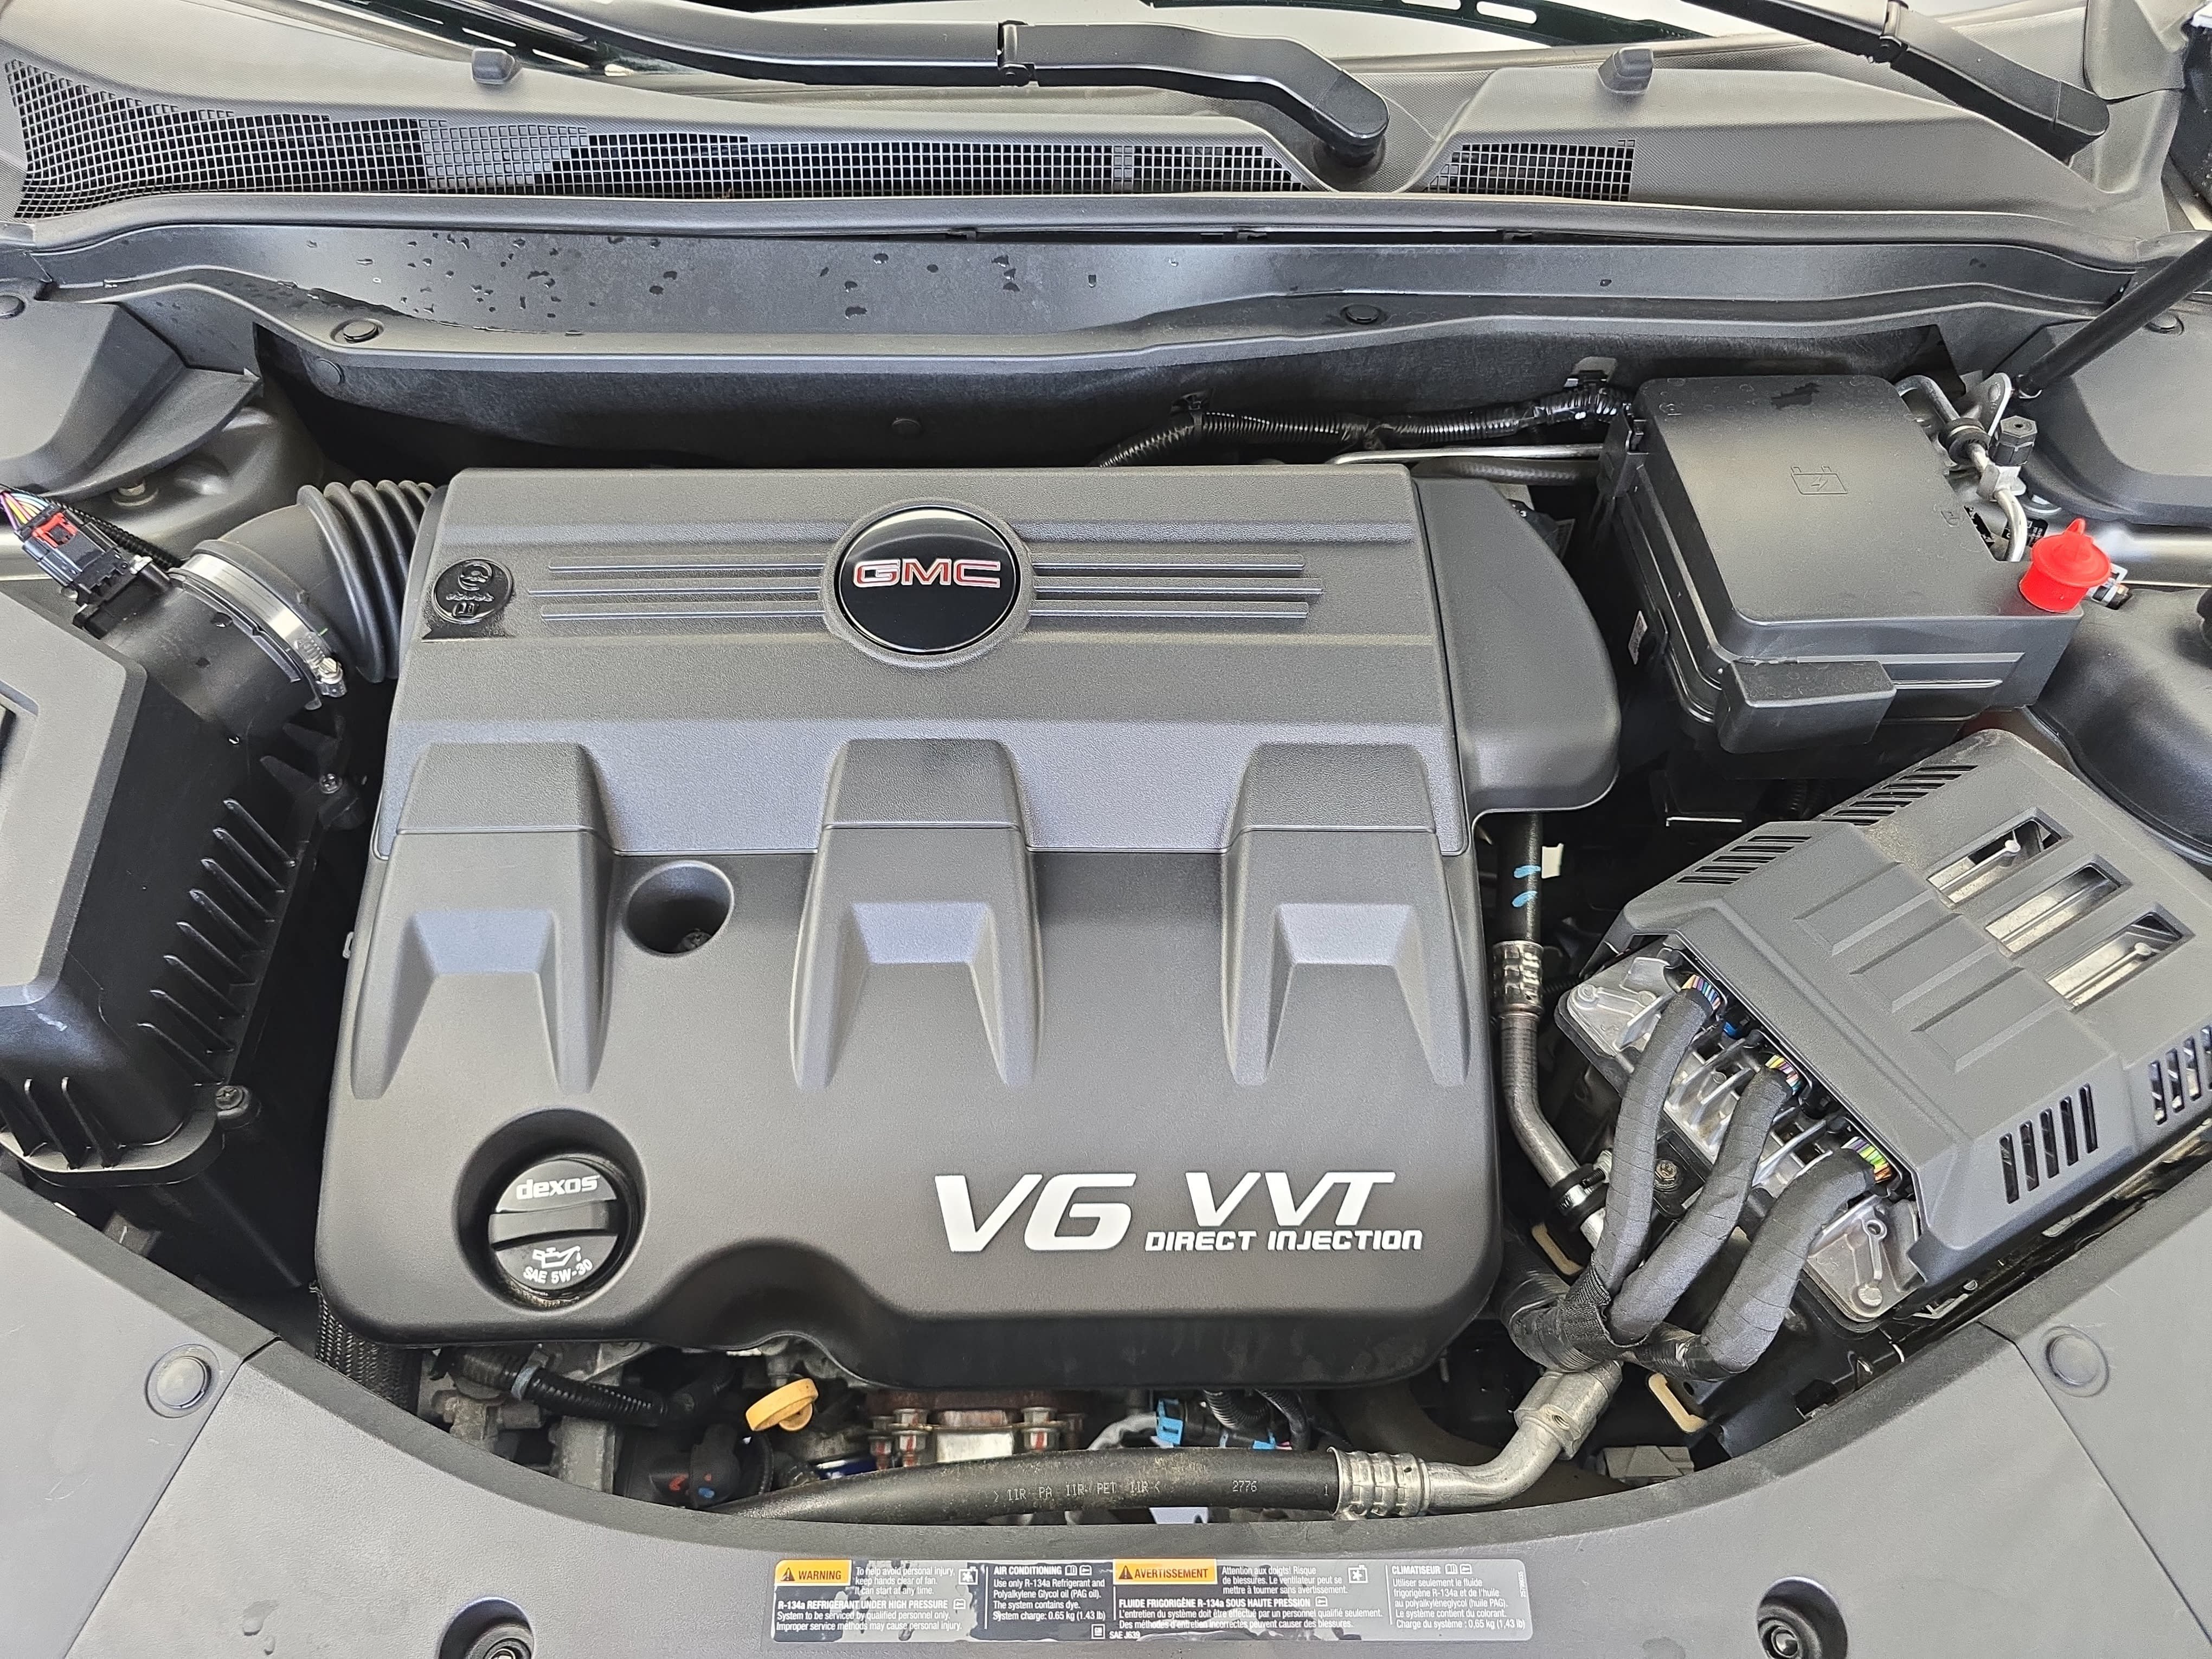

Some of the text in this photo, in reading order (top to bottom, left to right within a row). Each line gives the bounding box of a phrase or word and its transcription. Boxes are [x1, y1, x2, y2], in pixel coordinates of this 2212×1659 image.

[853, 558, 1001, 589] GMC
[516, 1175, 599, 1200] dexos
[1185, 1171, 1397, 1227] VVT
[935, 1172, 1137, 1252] V6
[1144, 1229, 1423, 1252] DIRECT INJECTION
[523, 1258, 594, 1284] SAE 5W-30
[1039, 1486, 1052, 1499] PA
[1097, 1482, 1116, 1494] PET
[1232, 1480, 1257, 1492] 2776
[799, 1570, 841, 1580] WARNING
[856, 1566, 955, 1577] To help avoid personal injury,
[994, 1566, 1062, 1575] AIR CONDITIONING
[1135, 1568, 1208, 1578] AVERTISSEMENT
[1222, 1566, 1252, 1575] Attention
[1268, 1566, 1291, 1576] doigts!
[1293, 1566, 1316, 1576] Risque
[1392, 1565, 1441, 1574] CLIMATISEUR
[856, 1577, 937, 1586] keep hands clear of fan.
[994, 1578, 1105, 1589] Use only R-134a Refrigerant and
[1222, 1576, 1231, 1584] de
[1233, 1576, 1268, 1584] blessures.
[1269, 1576, 1278, 1584] Le
[1279, 1576, 1315, 1584] ventilateur
[1317, 1576, 1332, 1585] peut
[1392, 1578, 1482, 1587] Utiliser seulement le fluide
[855, 1586, 860, 1594] It
[876, 1586, 892, 1594] start
[893, 1586, 901, 1594] at
[902, 1588, 916, 1596] any
[917, 1586, 934, 1594] time.
[993, 1590, 1101, 1600] Polyalkylene Glycol oil (PAG oil).
[1223, 1586, 1245, 1594] mettre
[1247, 1585, 1252, 1594] à
[1253, 1586, 1278, 1594] tourner
[1297, 1585, 1348, 1593] avertissement.
[1393, 1589, 1430, 1599] frigorigène
[1432, 1589, 1458, 1597] R-134a
[1468, 1589, 1477, 1597] de
[1478, 1588, 1500, 1597] l'huile
[777, 1600, 948, 1610] R-134a REFRIGERANT UNDER HIGH PRESSURE
[993, 1600, 1081, 1611] The system contains dye.
[1119, 1597, 1310, 1608] FLUIDE FRIGORIGÈNE R-134a SOUS HAUTE PRESSION
[1405, 1599, 1467, 1610] polyalkylèneglycol
[1469, 1599, 1488, 1608] (huile
[1489, 1599, 1508, 1609] PAG).
[777, 1611, 950, 1622] System to be serviced by qualified personnel only.
[993, 1611, 1105, 1622] System charge: 0.65 kg (1.43 lb)
[1119, 1610, 1156, 1618] L'entretien
[1158, 1610, 1166, 1618] du
[1168, 1609, 1197, 1619] système
[1198, 1610, 1212, 1618] doit
[1213, 1609, 1227, 1618] être
[1229, 1609, 1256, 1618] effectué
[1258, 1610, 1271, 1619] par
[1282, 1609, 1316, 1618] personnel
[1318, 1608, 1342, 1618] qualifié
[1345, 1609, 1383, 1617] seulement.
[1396, 1609, 1507, 1620] Le système contient du colorant.
[776, 1622, 809, 1632] Improper
[810, 1622, 835, 1630] service
[837, 1622, 867, 1630] methods
[870, 1623, 885, 1631] may
[909, 1622, 939, 1631] personal
[941, 1622, 962, 1632] injury.
[1119, 1620, 1133, 1629] Des
[1134, 1619, 1169, 1629] méthodes
[1210, 1620, 1247, 1628] incorrectes
[1249, 1619, 1277, 1629] peuvent
[1278, 1620, 1302, 1628] causer
[1303, 1619, 1316, 1628] des
[1318, 1619, 1353, 1627] blessures.
[1397, 1619, 1421, 1630] Charge
[1423, 1619, 1431, 1628] du
[1433, 1619, 1463, 1630] système
[1468, 1619, 1484, 1629] 0,65
[1486, 1619, 1495, 1630] kg
[1496, 1619, 1515, 1629] (1,43
[1516, 1619, 1525, 1629] lb)
[1109, 1630, 1141, 1639] SAE J639
